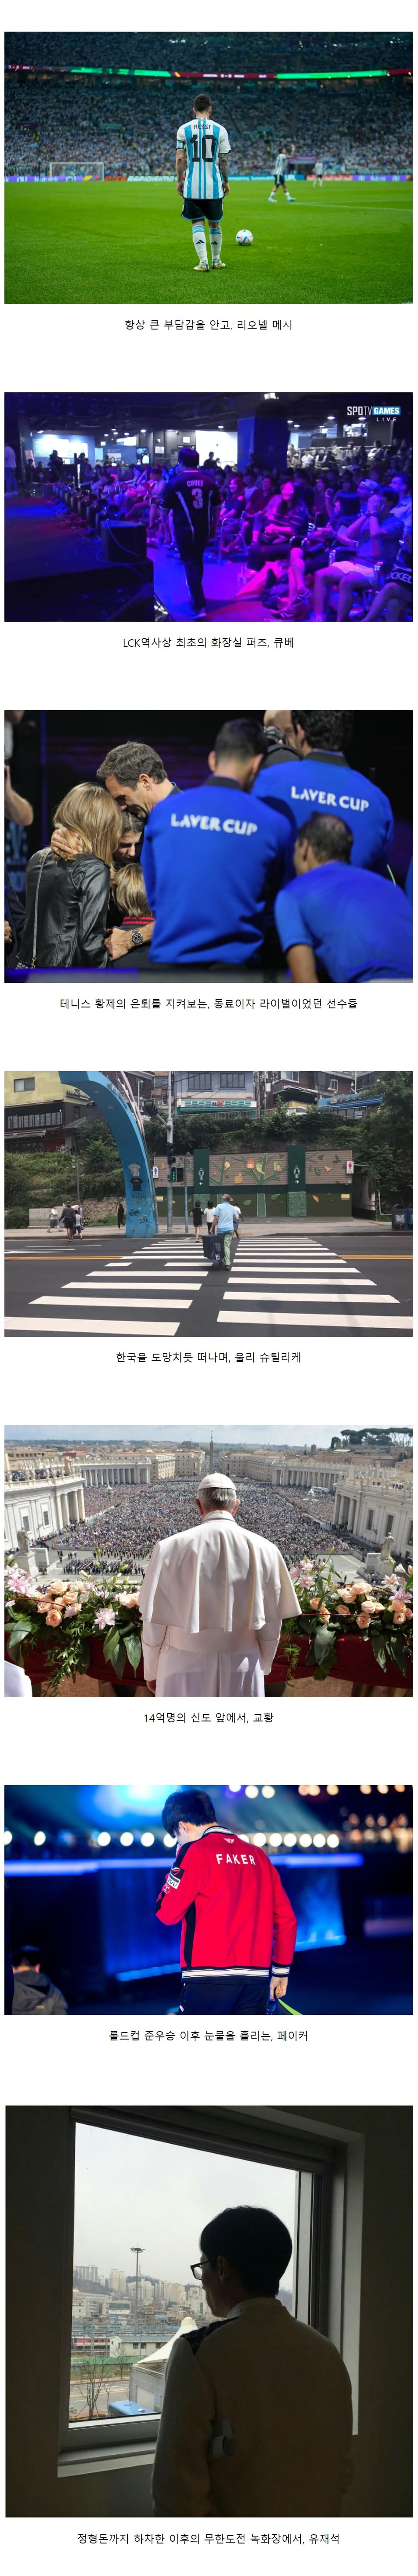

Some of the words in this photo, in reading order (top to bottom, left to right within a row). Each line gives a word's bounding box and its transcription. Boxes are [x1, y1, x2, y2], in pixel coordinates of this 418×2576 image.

[190, 134, 218, 162] 10
[191, 488, 203, 508] 3
[291, 786, 338, 807] LAVER
[339, 795, 369, 812] CUP
[171, 813, 221, 832] LAVER
[222, 819, 258, 836] CUP
[216, 1853, 256, 1866] FAKER
